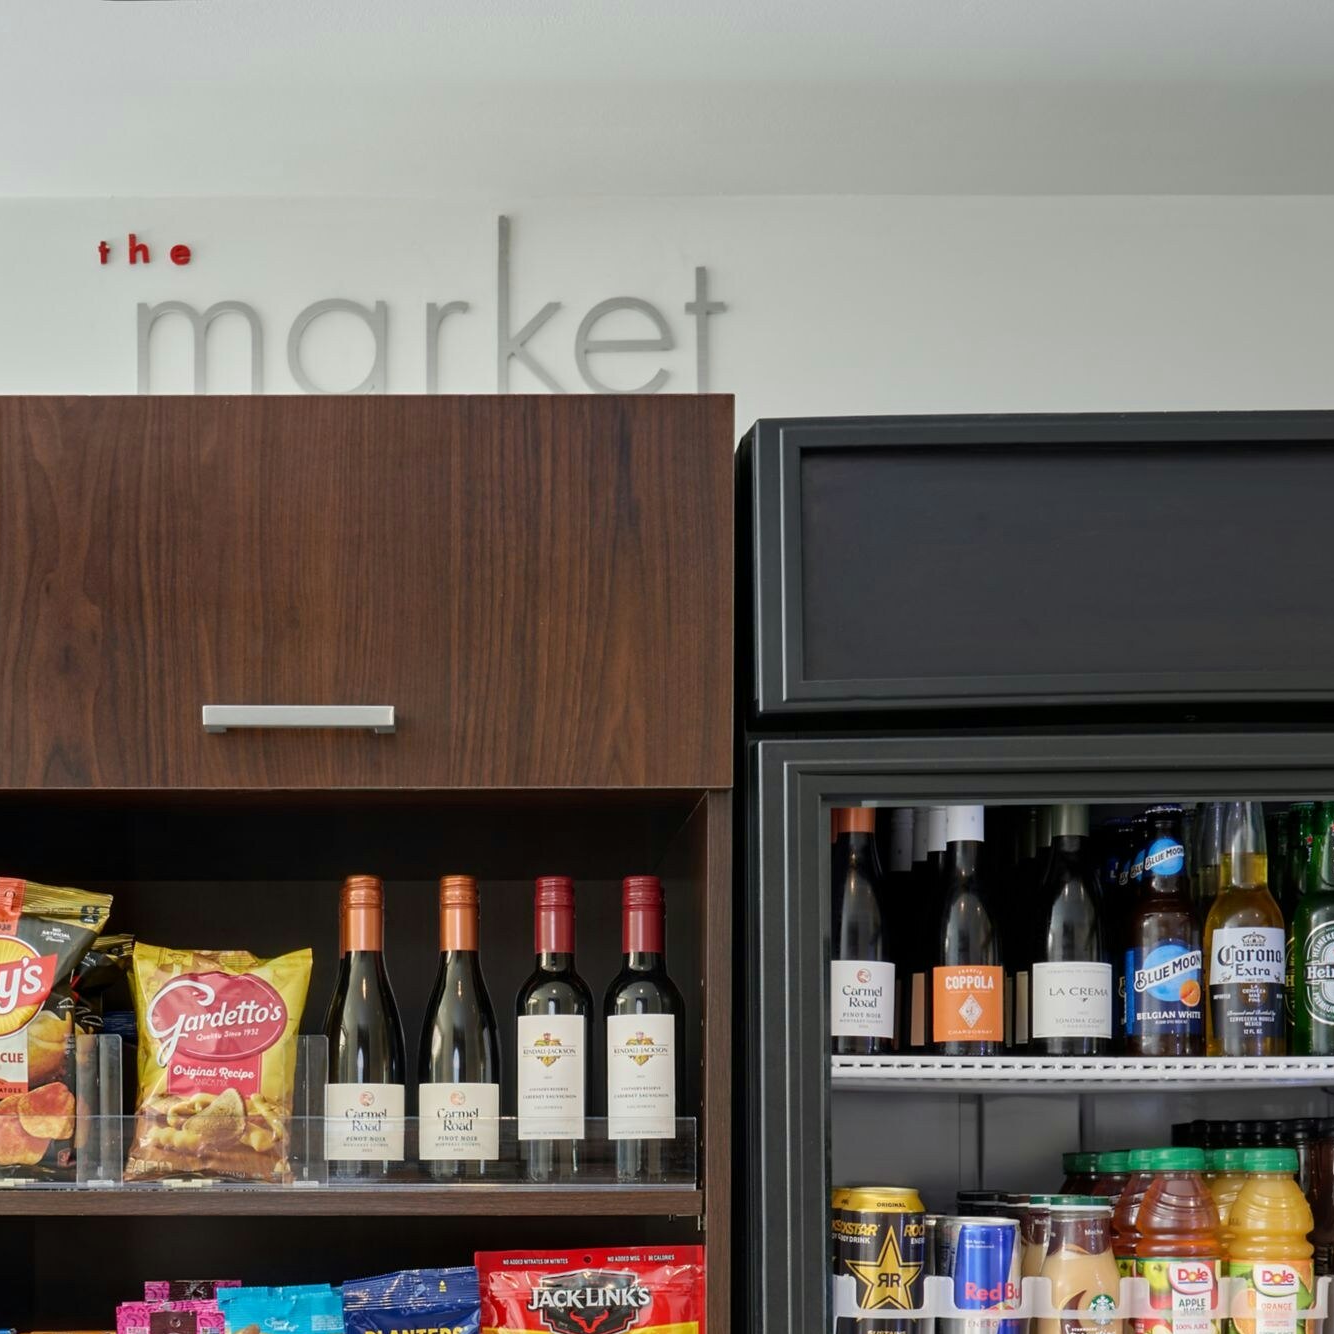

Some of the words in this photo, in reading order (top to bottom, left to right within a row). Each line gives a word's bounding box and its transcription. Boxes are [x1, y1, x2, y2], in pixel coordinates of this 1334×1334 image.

[98, 234, 191, 266] the
[137, 215, 727, 394] market
[1217, 944, 1282, 965] Corona
[1236, 964, 1271, 976] Extra
[945, 976, 994, 990] COPPOLA
[1135, 966, 1170, 992] BLUE
[1050, 987, 1064, 996] LA
[1070, 987, 1108, 997] CREMA
[1137, 1011, 1176, 1020] BELGIAN
[1178, 1011, 1201, 1019] WHITE
[148, 980, 281, 1067] Gardetto's
[173, 1066, 216, 1080] Original
[220, 1067, 254, 1079] Recipe
[345, 1109, 387, 1119] Carmel
[352, 1119, 381, 1131] Road
[1177, 1270, 1208, 1282] Dole
[965, 1283, 1001, 1300] Red
[1179, 1299, 1205, 1307] APPLE
